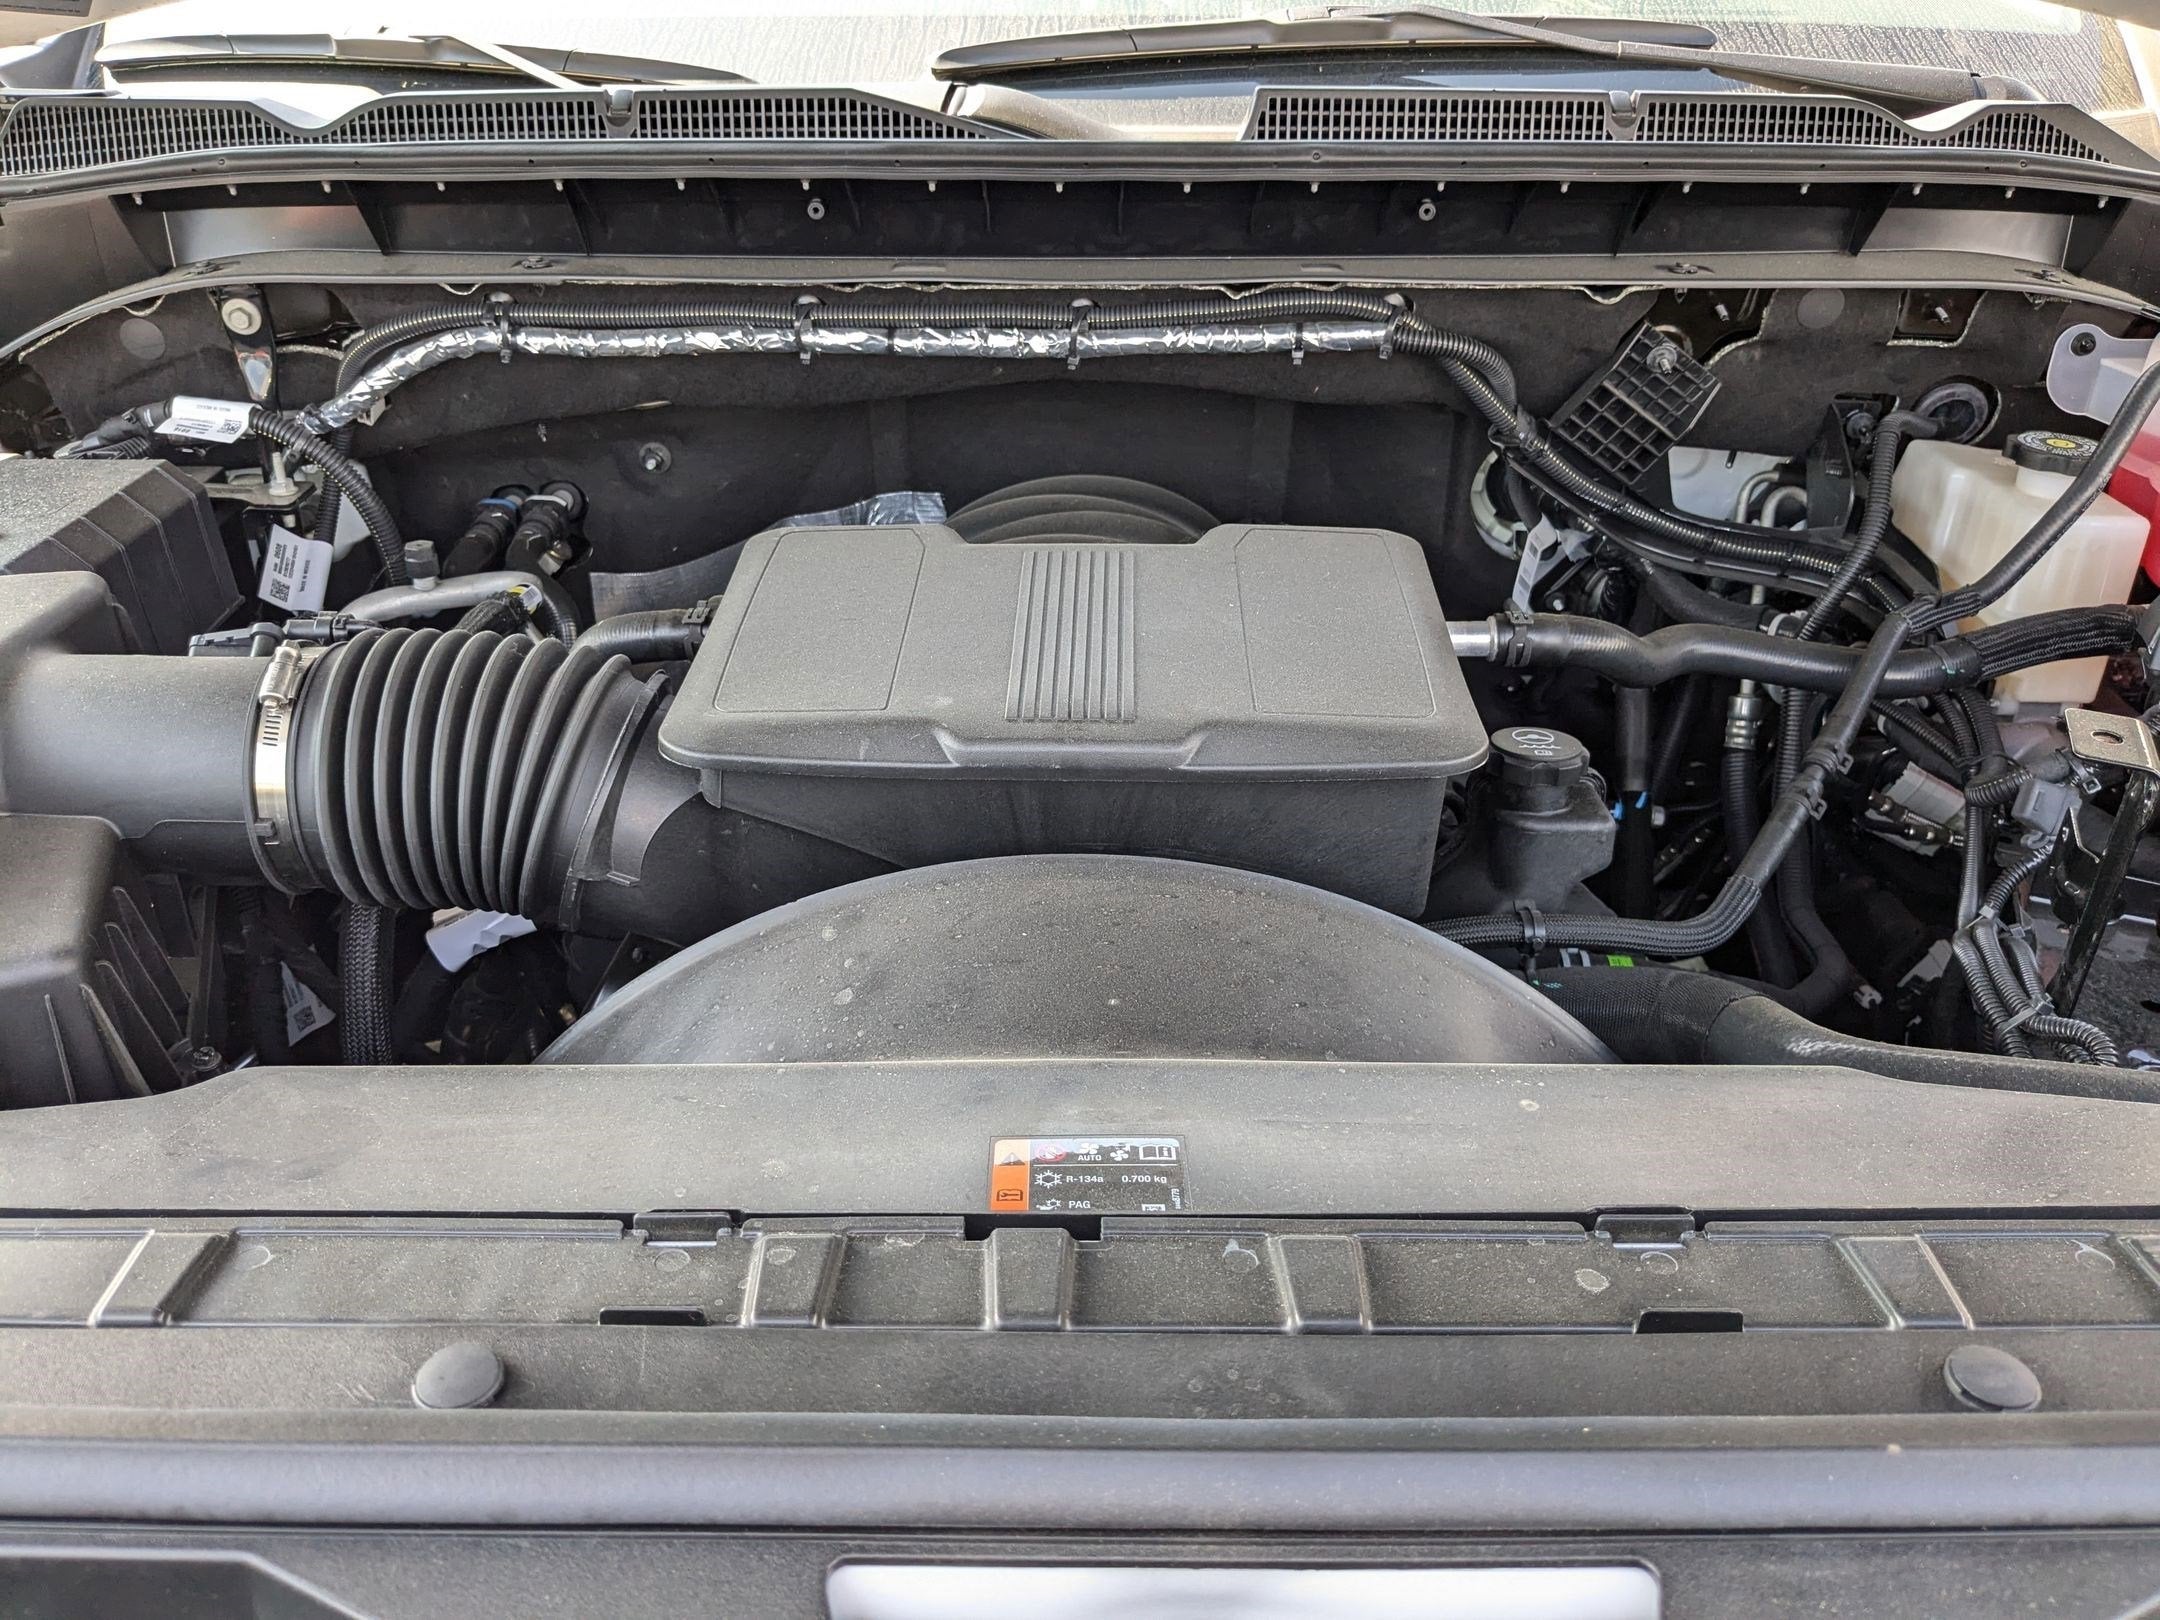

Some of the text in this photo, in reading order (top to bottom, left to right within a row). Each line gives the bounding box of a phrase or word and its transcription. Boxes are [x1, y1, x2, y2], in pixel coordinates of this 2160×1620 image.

[1077, 1154, 1102, 1162] AUTO
[1066, 1175, 1167, 1185] R-134a 0.700 kg
[1068, 1200, 1091, 1209] PAG
